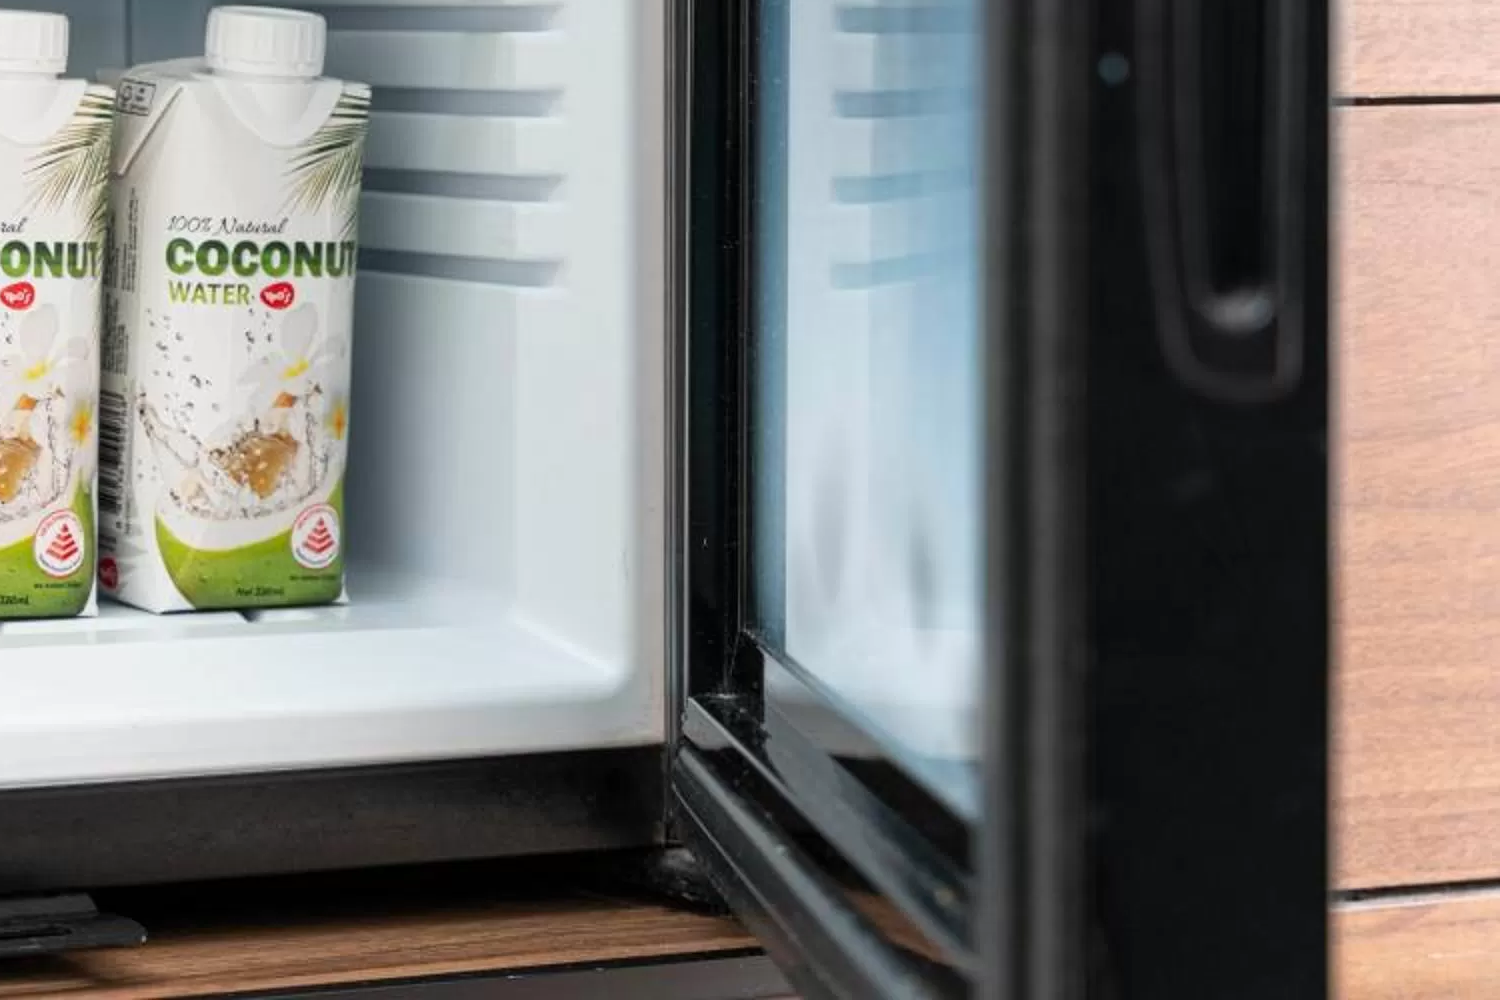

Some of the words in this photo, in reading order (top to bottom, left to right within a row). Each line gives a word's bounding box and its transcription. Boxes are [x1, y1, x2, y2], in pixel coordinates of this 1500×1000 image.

[167, 215, 212, 233] 100%
[213, 217, 289, 235] Natural
[168, 280, 250, 305] WATER
